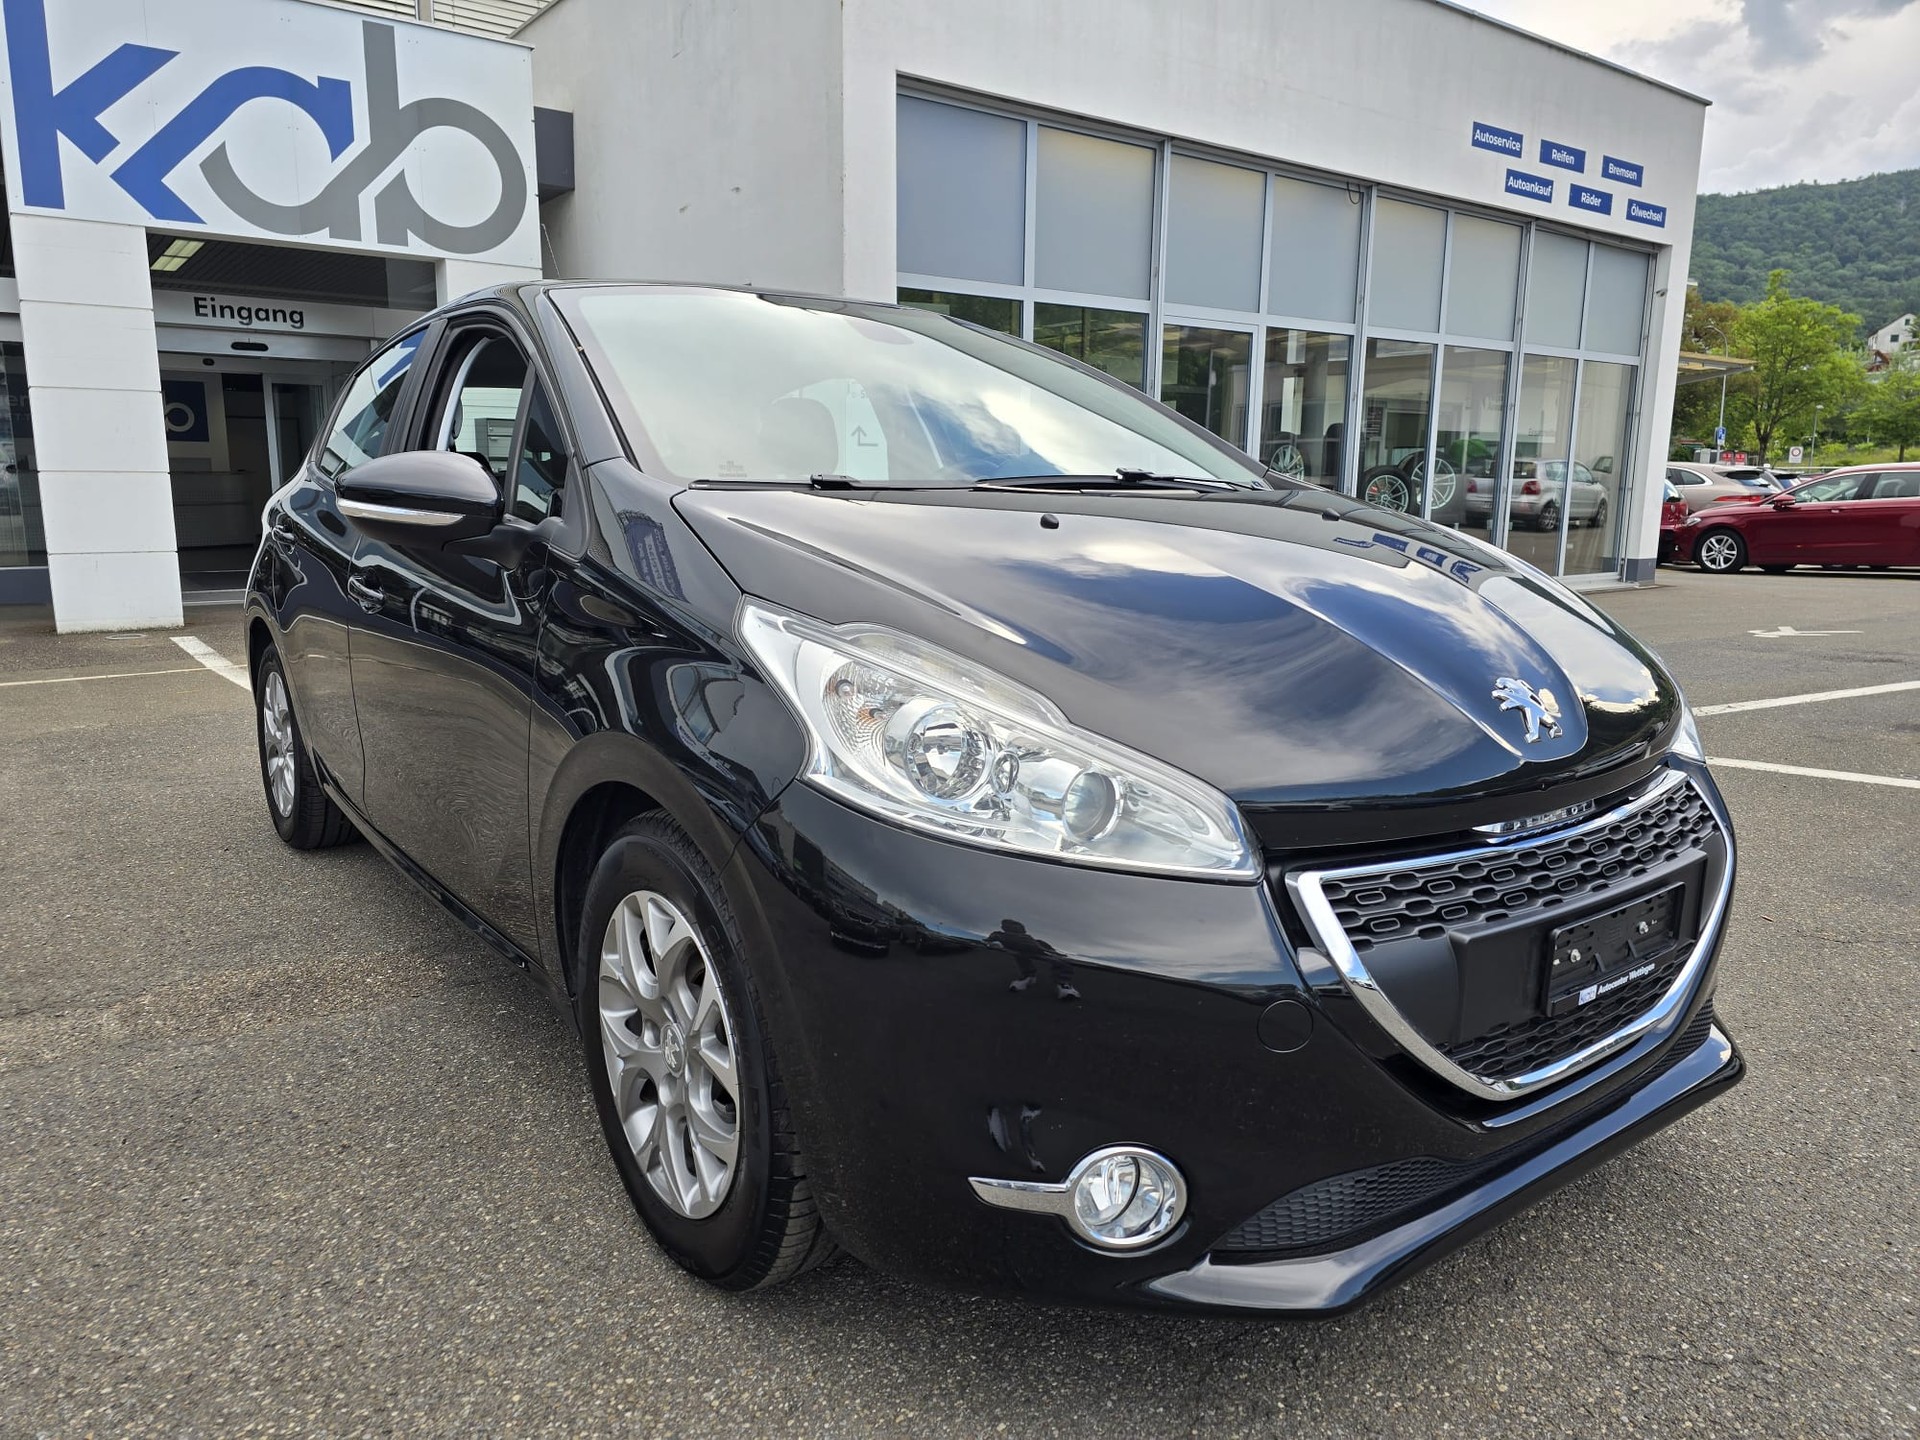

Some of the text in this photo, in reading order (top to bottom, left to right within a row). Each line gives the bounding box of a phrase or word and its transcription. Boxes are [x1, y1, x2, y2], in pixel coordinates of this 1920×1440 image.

[4, 0, 527, 255] kab
[1474, 129, 1521, 151] Autoservice
[1552, 149, 1575, 165] Reifen
[1608, 163, 1638, 181] Bremsen
[1508, 175, 1552, 197] Autoankauf
[1581, 192, 1602, 207] Räder
[1630, 203, 1663, 223] Ölwechsel
[193, 296, 305, 329] Eingang
